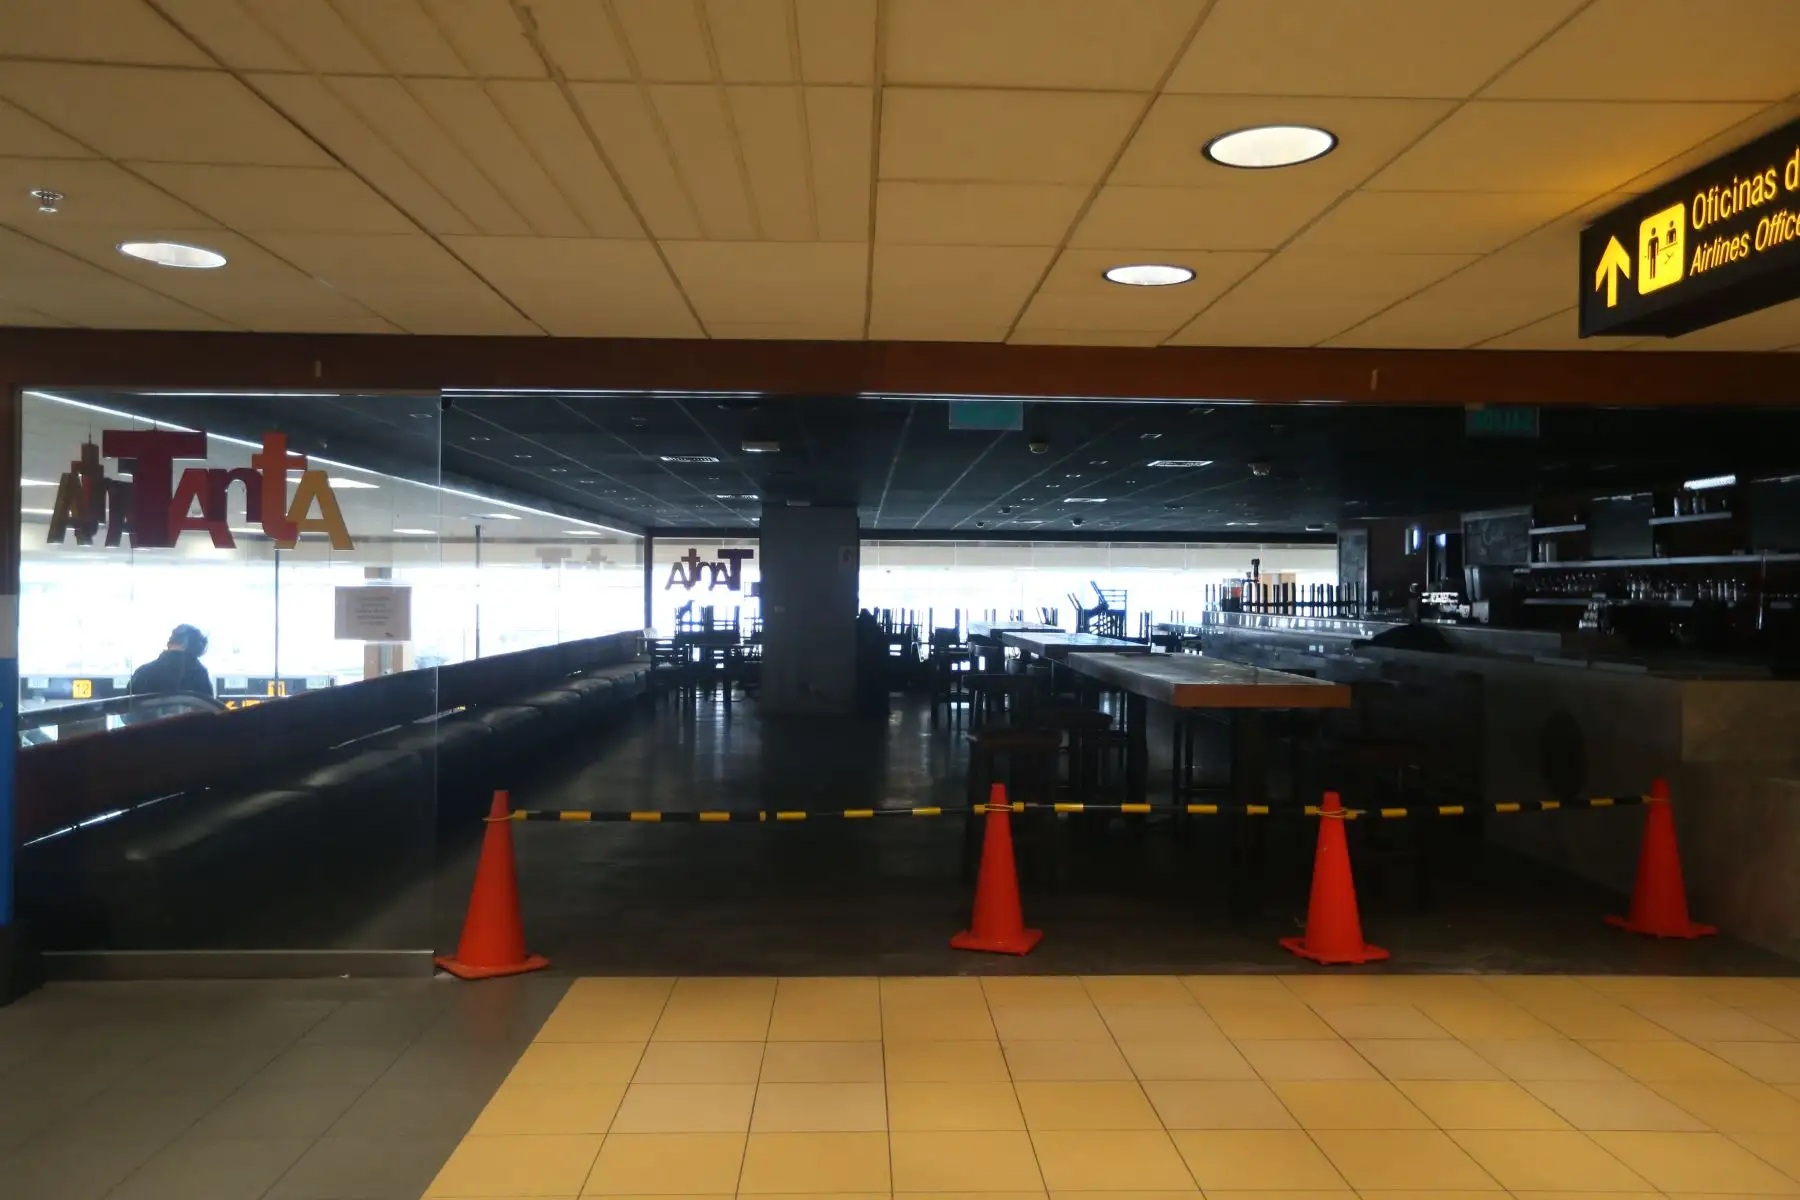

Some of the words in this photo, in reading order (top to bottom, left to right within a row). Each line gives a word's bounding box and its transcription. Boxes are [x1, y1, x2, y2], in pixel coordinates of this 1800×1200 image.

[1692, 167, 1777, 230] Oficinas
[1689, 233, 1750, 276] Airlines
[76, 683, 90, 696] 12
